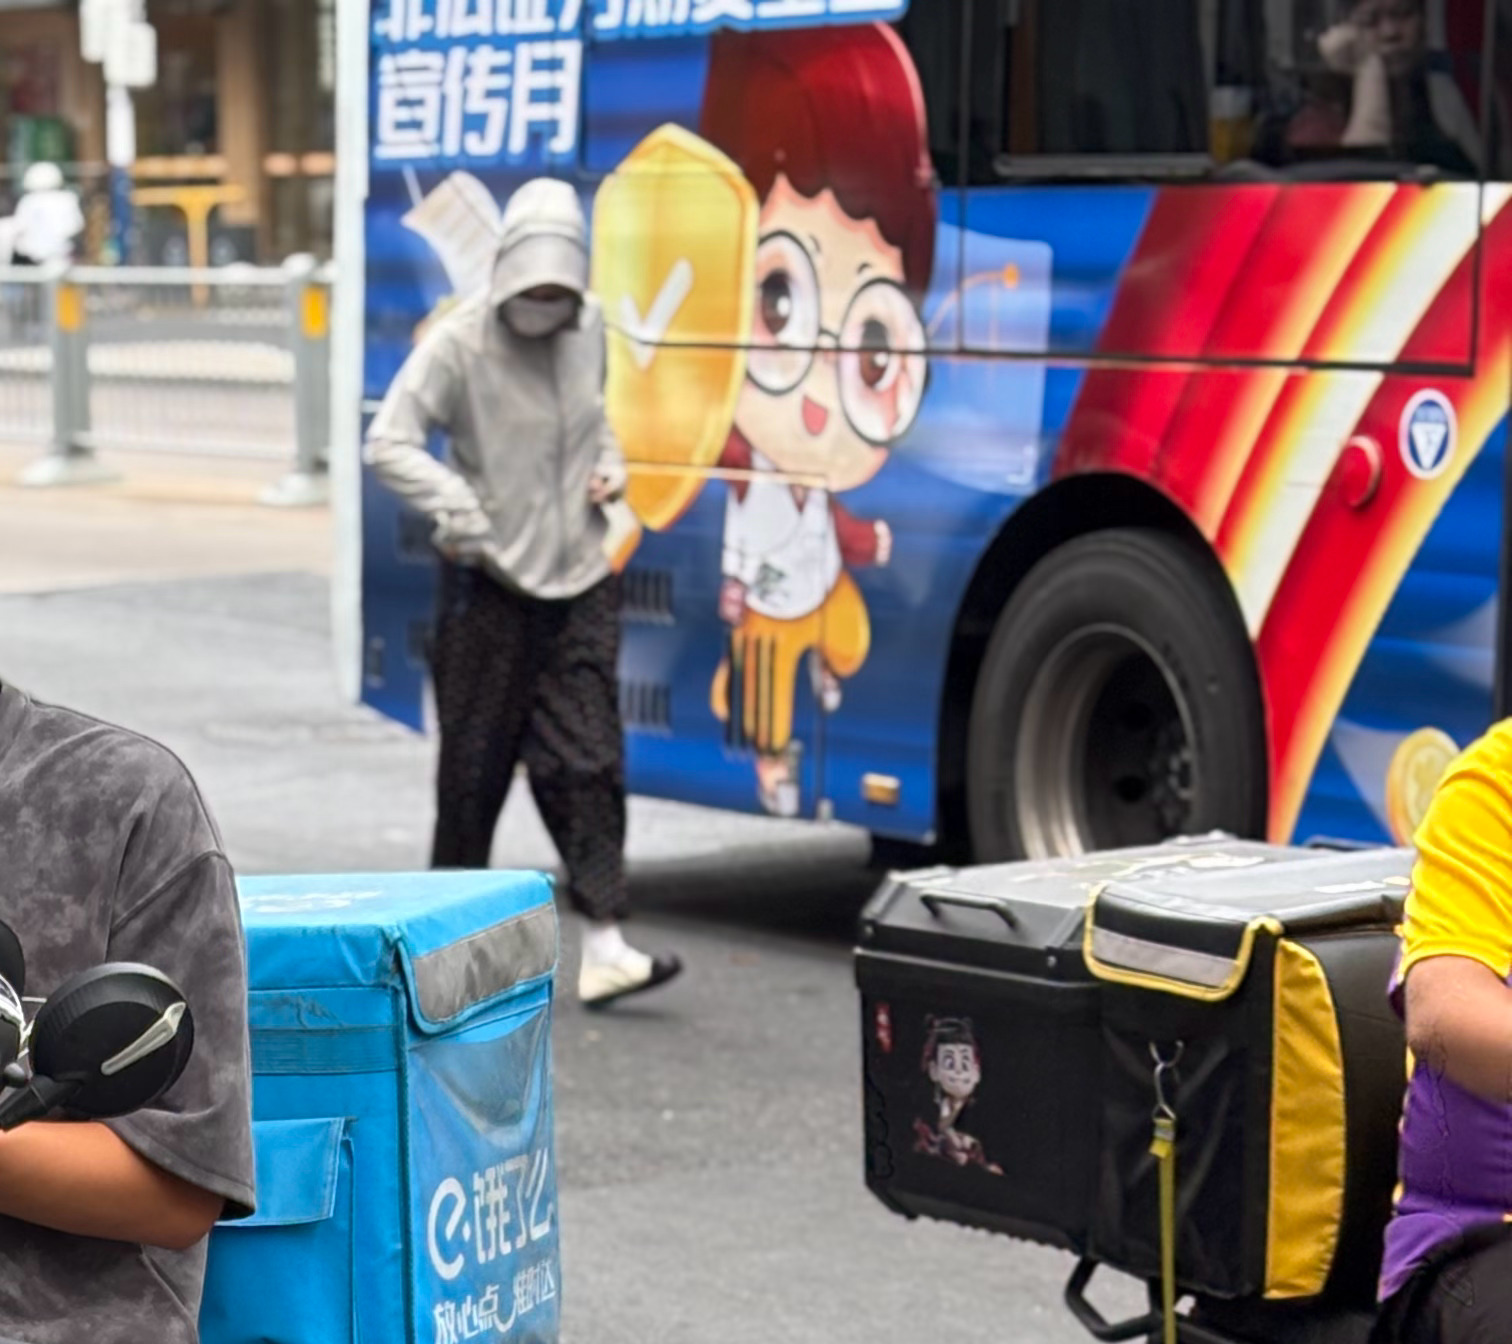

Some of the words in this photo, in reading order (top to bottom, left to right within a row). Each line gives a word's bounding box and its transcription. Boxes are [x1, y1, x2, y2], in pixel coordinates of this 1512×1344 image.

[374, 39, 583, 159] 宣传月
[473, 1147, 555, 1264] 饿了么
